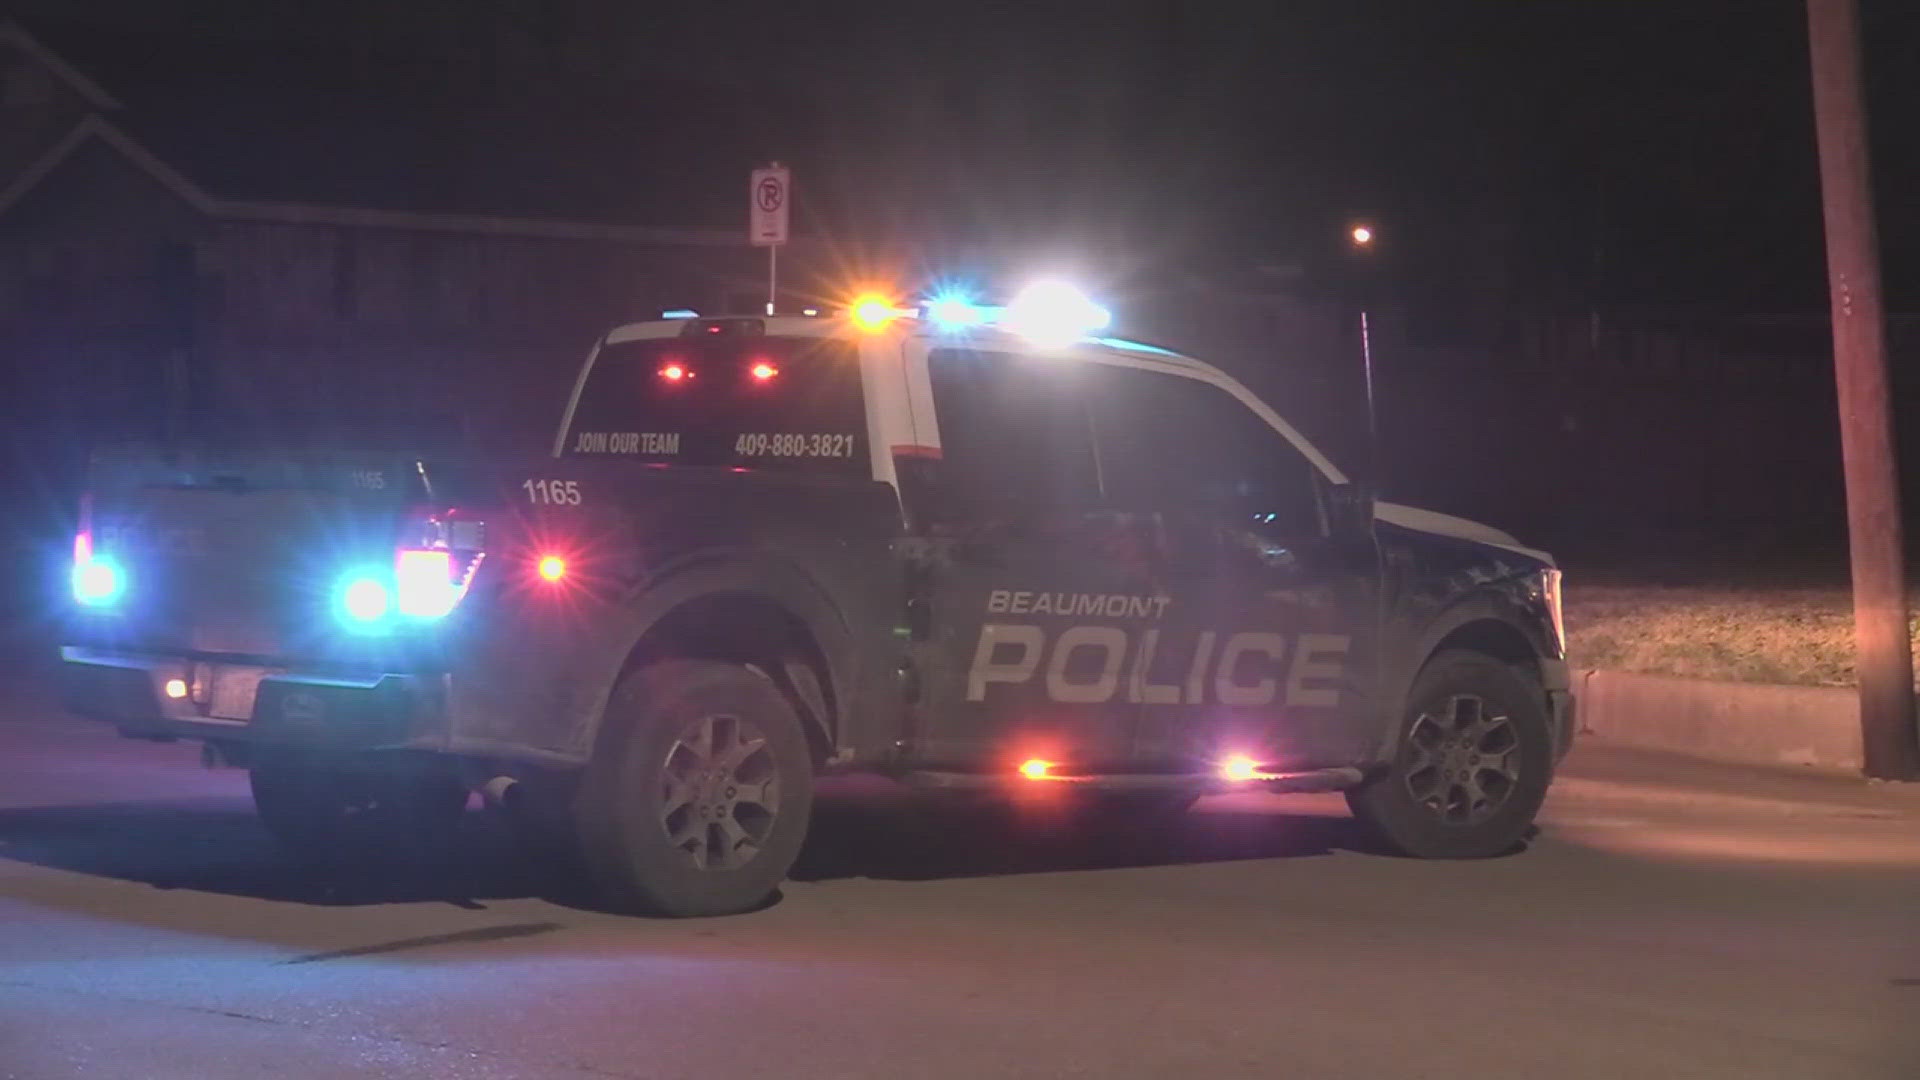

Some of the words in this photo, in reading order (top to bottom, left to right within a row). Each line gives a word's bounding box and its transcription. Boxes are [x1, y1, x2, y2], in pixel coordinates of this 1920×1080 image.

[574, 433, 606, 452] JOIN
[610, 433, 638, 453] OUR
[640, 433, 679, 454] TEAM
[735, 433, 853, 456] 409-880-3821
[523, 479, 581, 505] 1165
[987, 590, 1170, 618] BEAUMONT
[966, 624, 1352, 706] POLICE
